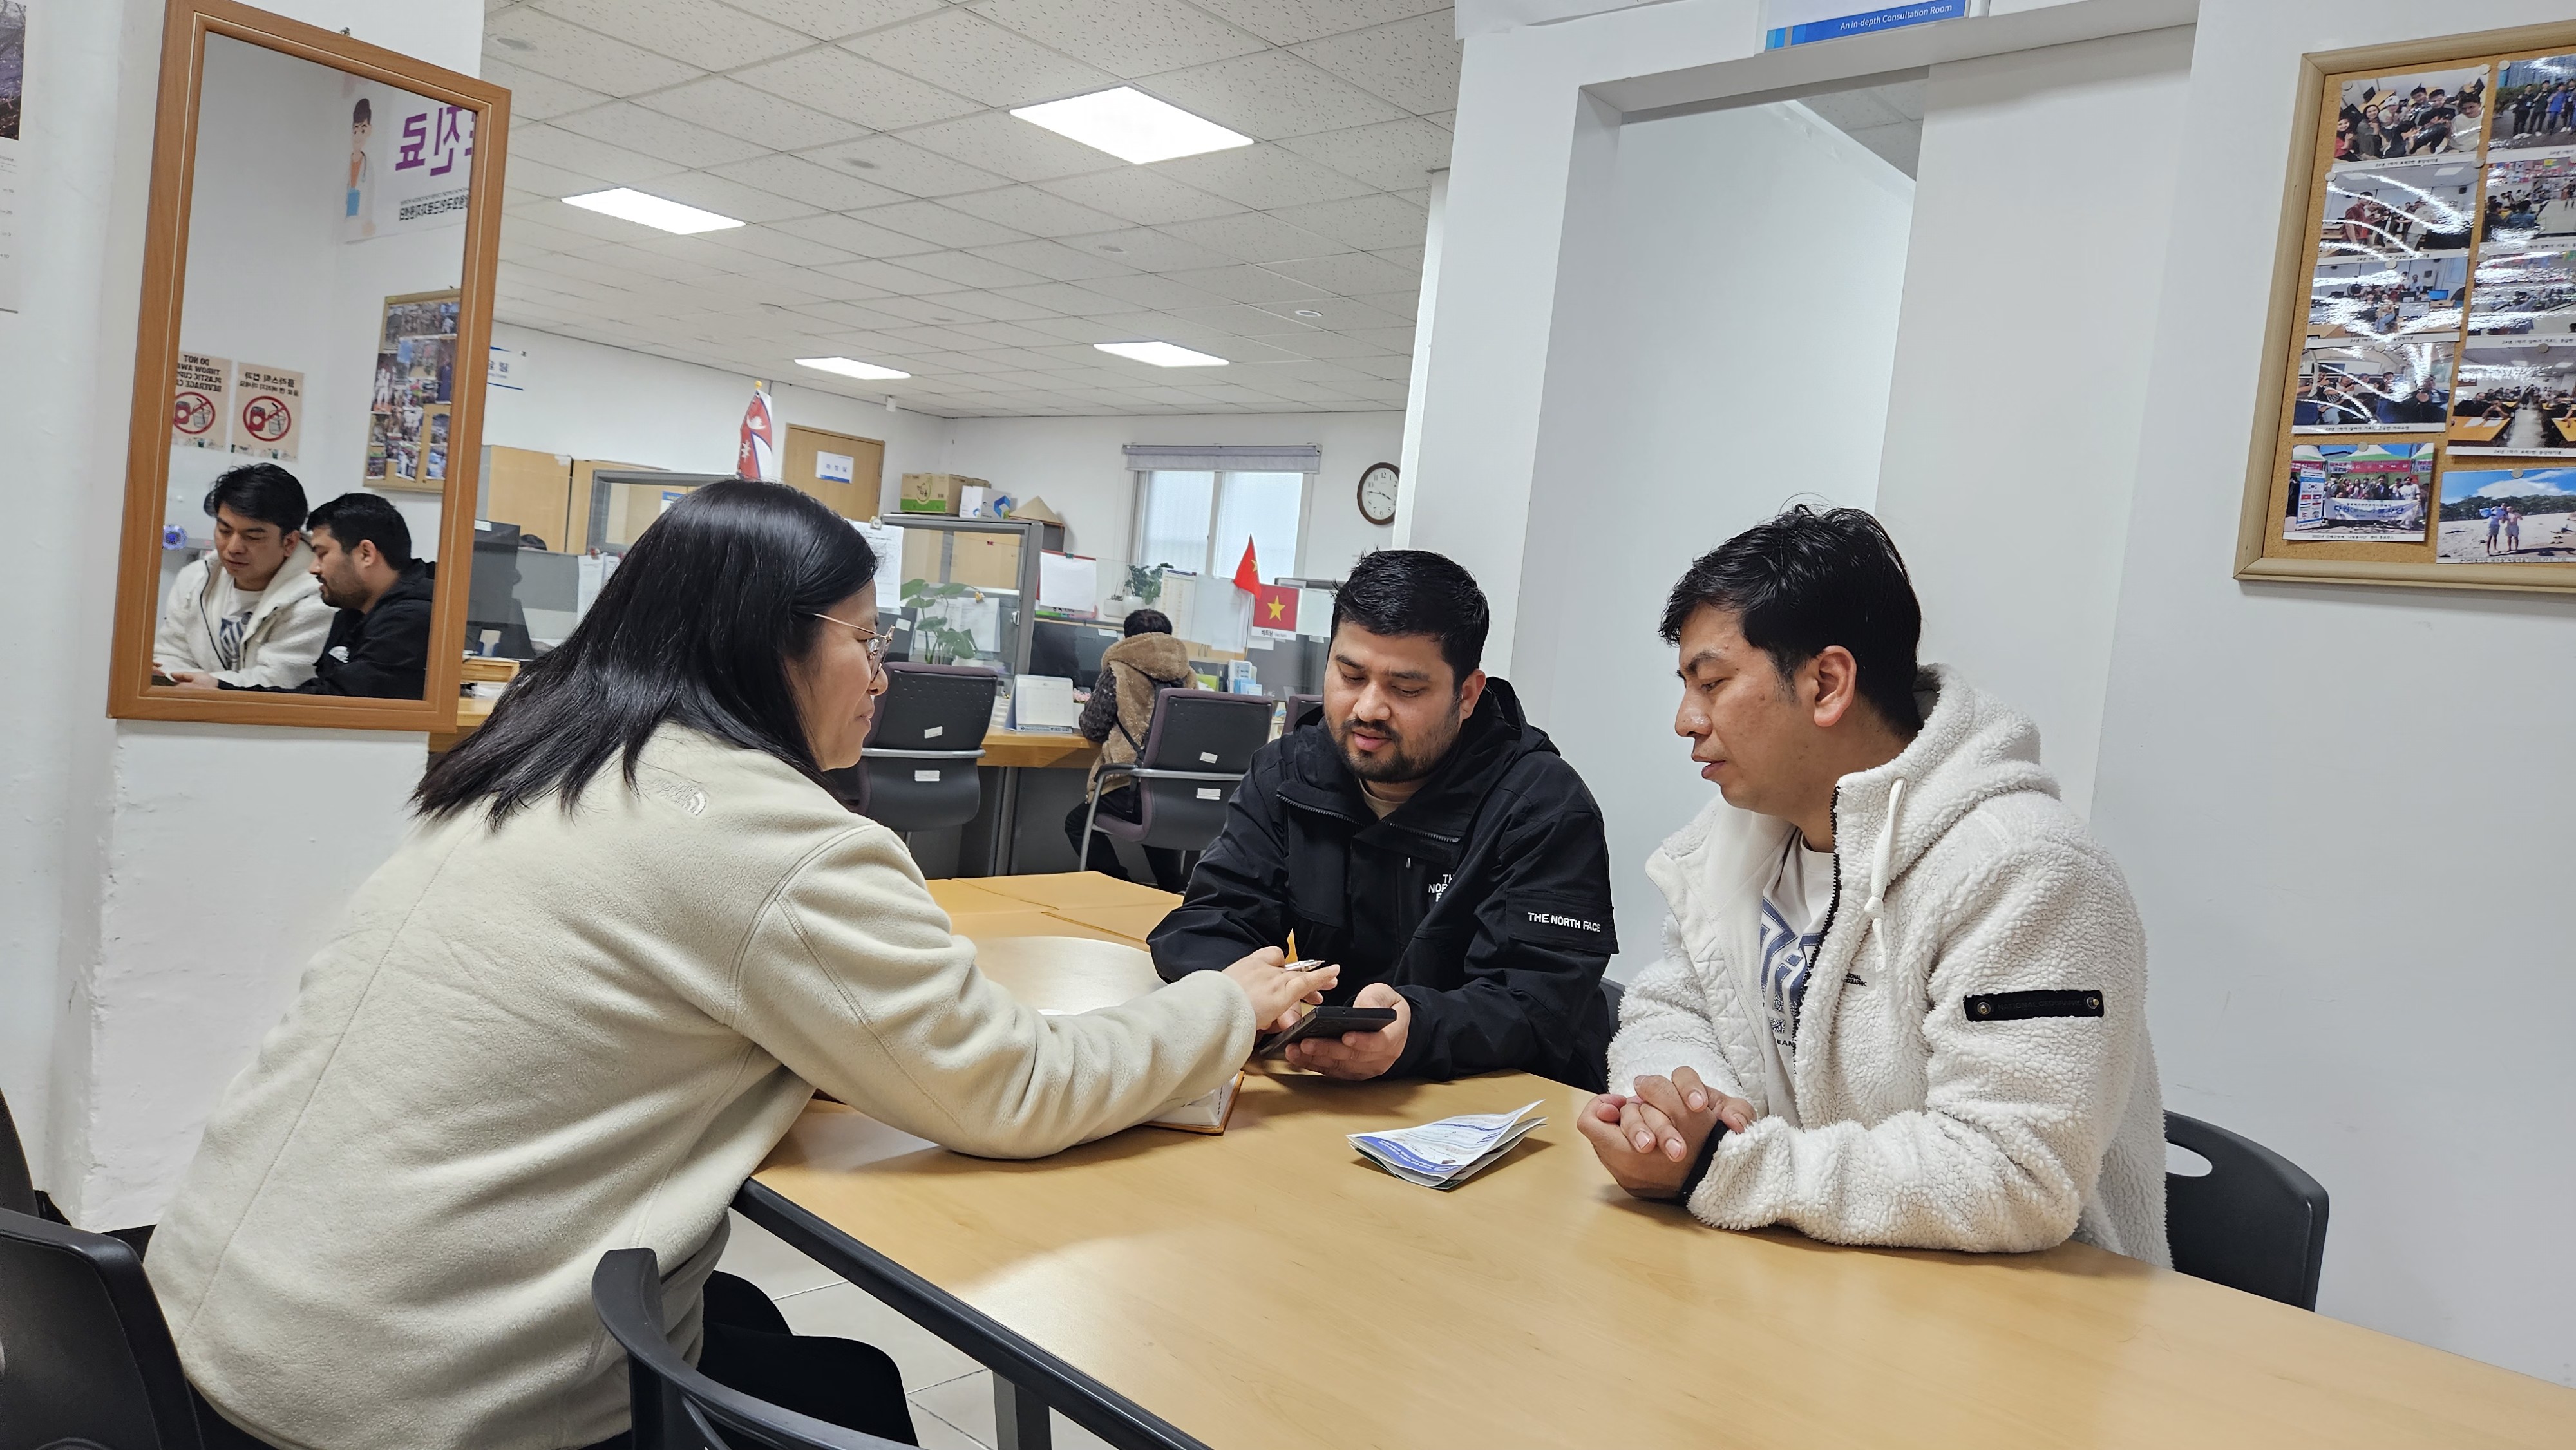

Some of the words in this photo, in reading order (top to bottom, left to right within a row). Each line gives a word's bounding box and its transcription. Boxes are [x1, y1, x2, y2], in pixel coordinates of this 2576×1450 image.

[1840, 22, 1850, 30] An
[1851, 17, 1881, 28] in-depth
[1882, 8, 1928, 23] Consultation
[1930, 5, 1952, 14] Room
[1443, 874, 1455, 883] TH
[1428, 883, 1448, 893] NOR
[1528, 912, 1549, 923] THE
[1551, 915, 1581, 929] NORTH
[1582, 921, 1601, 932] FACE
